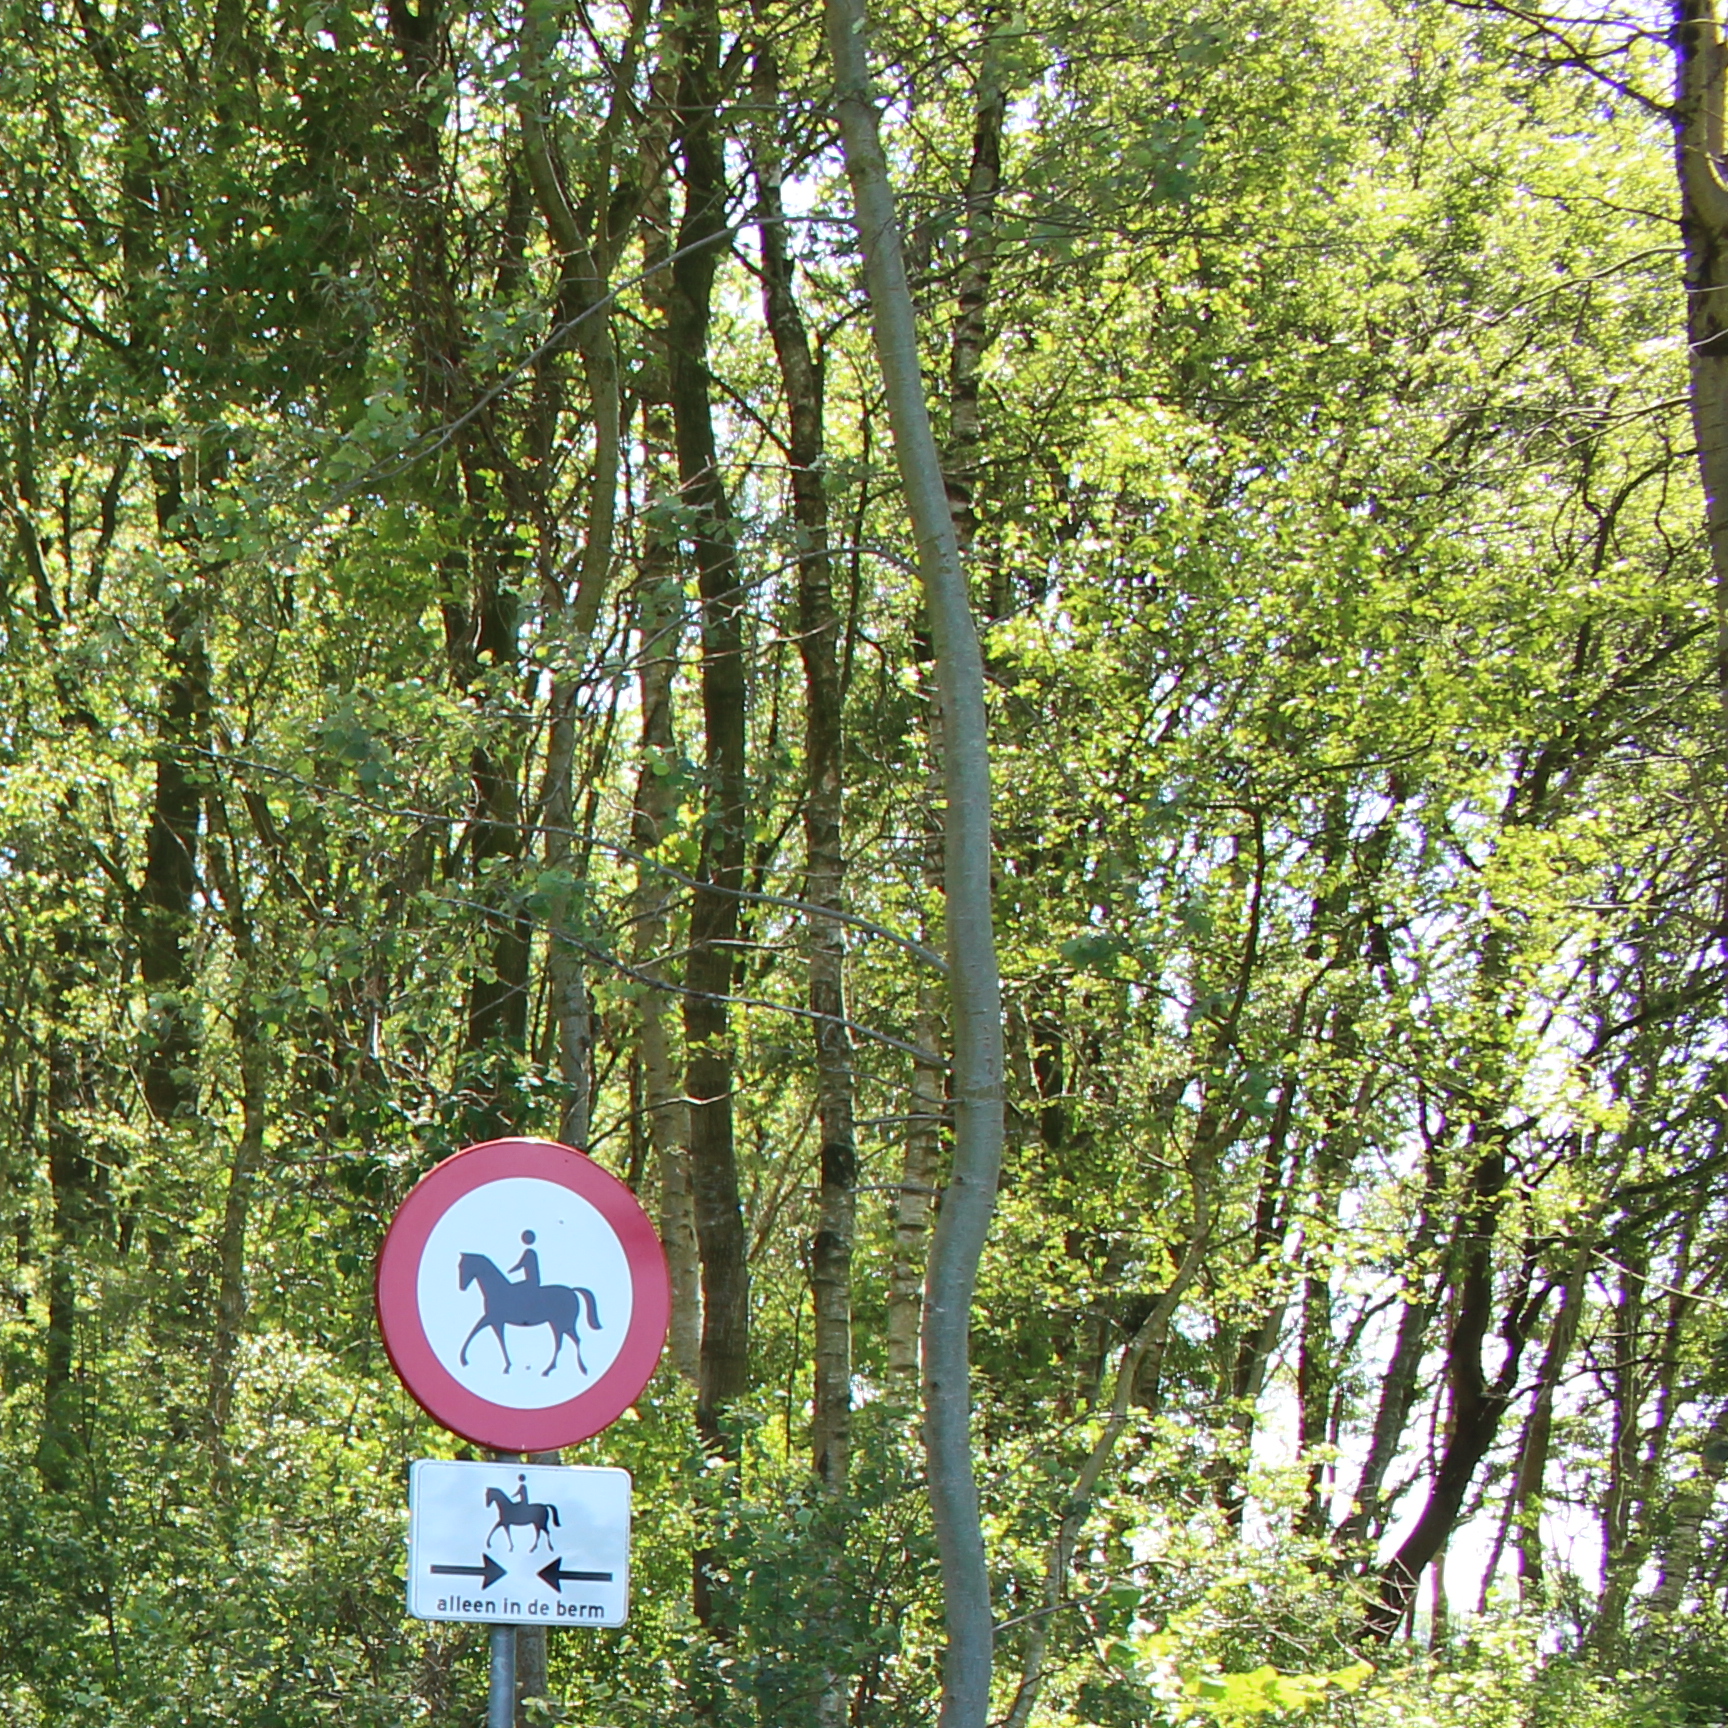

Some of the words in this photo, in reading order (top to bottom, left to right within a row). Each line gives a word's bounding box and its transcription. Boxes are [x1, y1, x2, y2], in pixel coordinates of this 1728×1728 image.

[437, 1595, 496, 1613] alleen
[503, 1597, 521, 1615] in
[528, 1599, 550, 1616] de
[556, 1600, 605, 1618] berm
